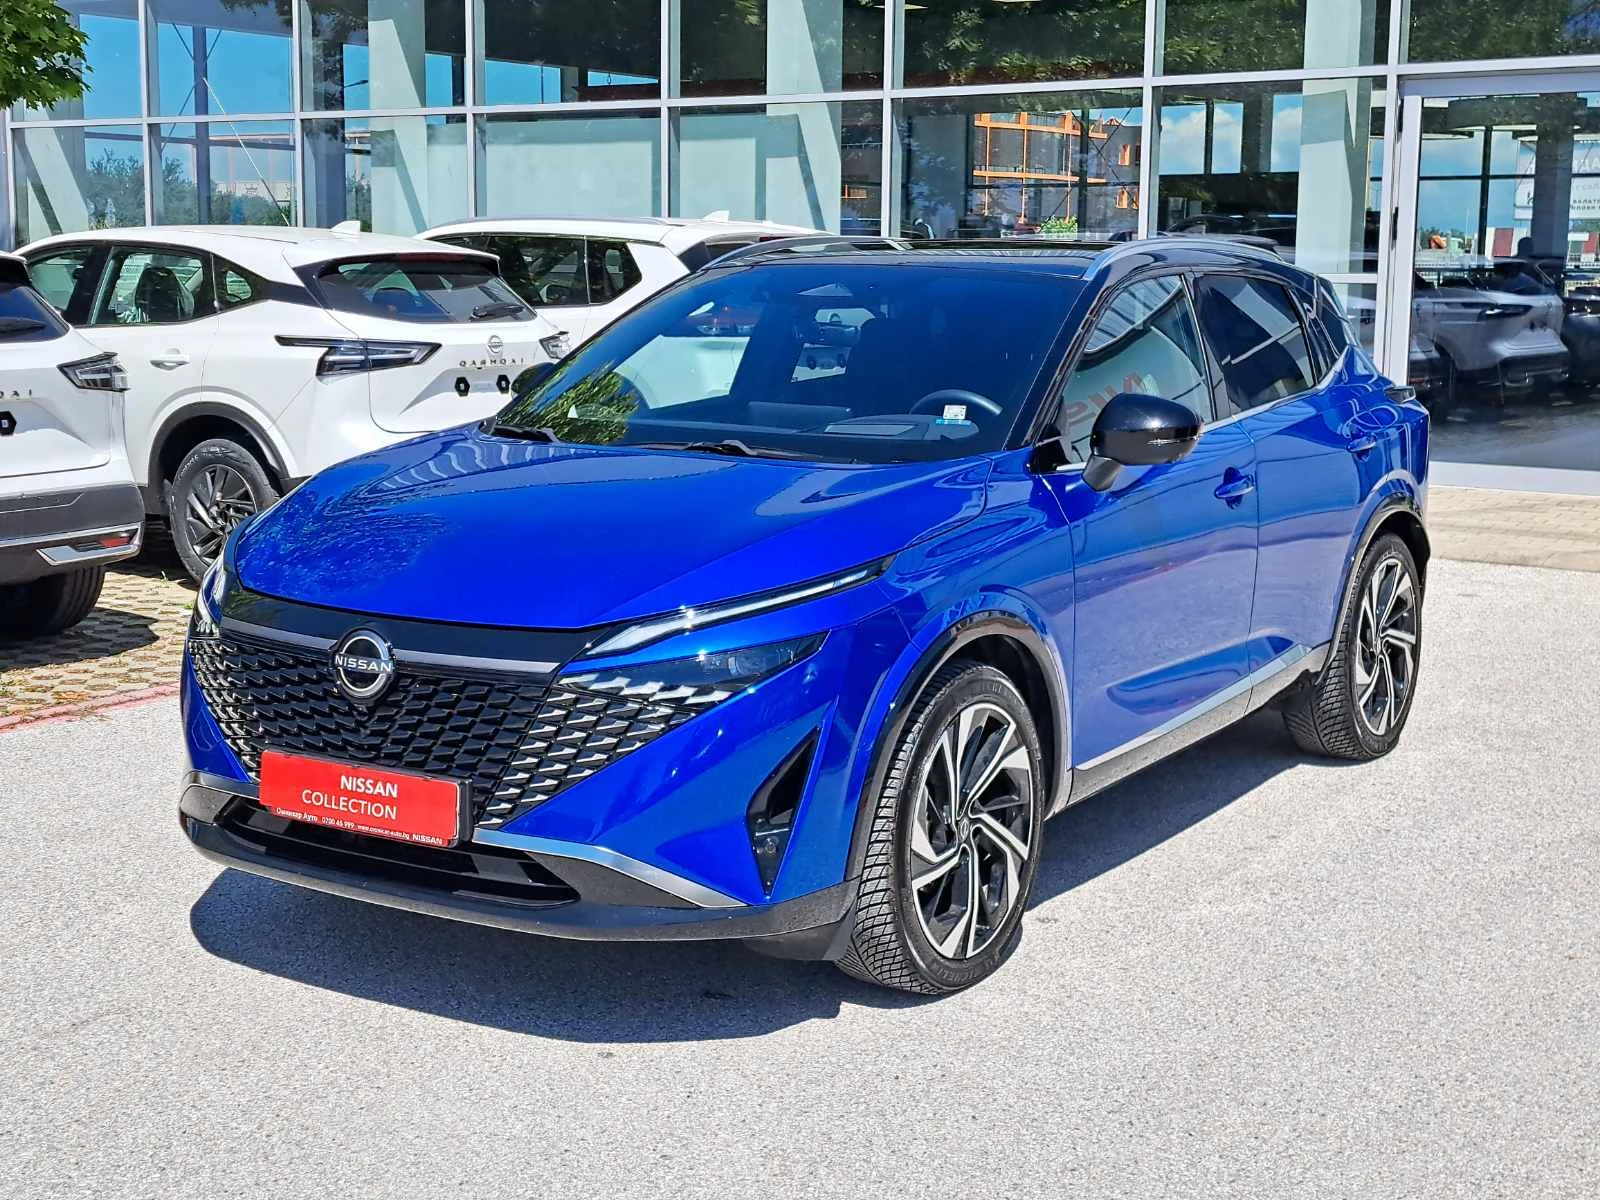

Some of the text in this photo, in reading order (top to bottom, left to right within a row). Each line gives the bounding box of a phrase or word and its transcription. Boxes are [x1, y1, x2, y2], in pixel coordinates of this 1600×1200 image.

[334, 655, 392, 672] NISSAN
[340, 775, 398, 797] NISSAN
[301, 789, 397, 820] COLLECTION
[413, 833, 442, 844] NISSAN
